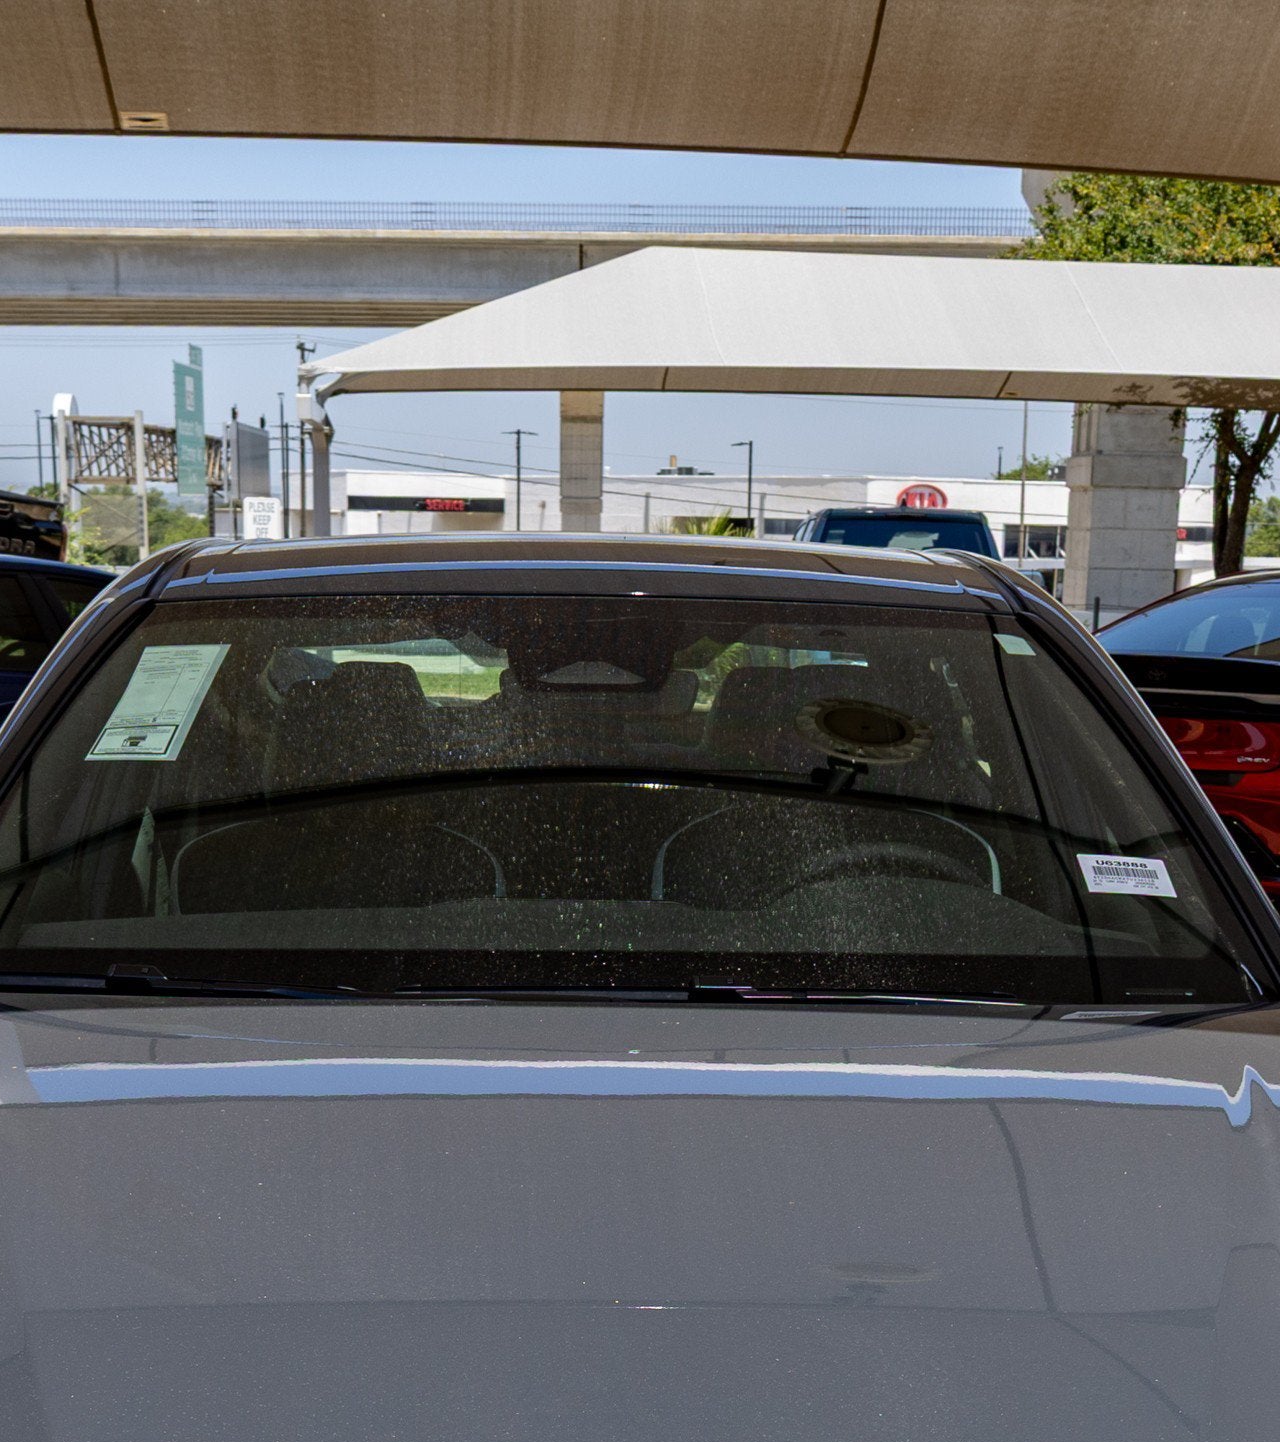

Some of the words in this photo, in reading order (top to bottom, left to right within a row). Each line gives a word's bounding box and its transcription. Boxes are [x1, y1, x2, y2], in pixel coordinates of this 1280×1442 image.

[249, 502, 276, 513] PLEASE
[425, 499, 465, 511] SERVICE
[253, 515, 272, 525] KEEP
[256, 527, 270, 538] OFF
